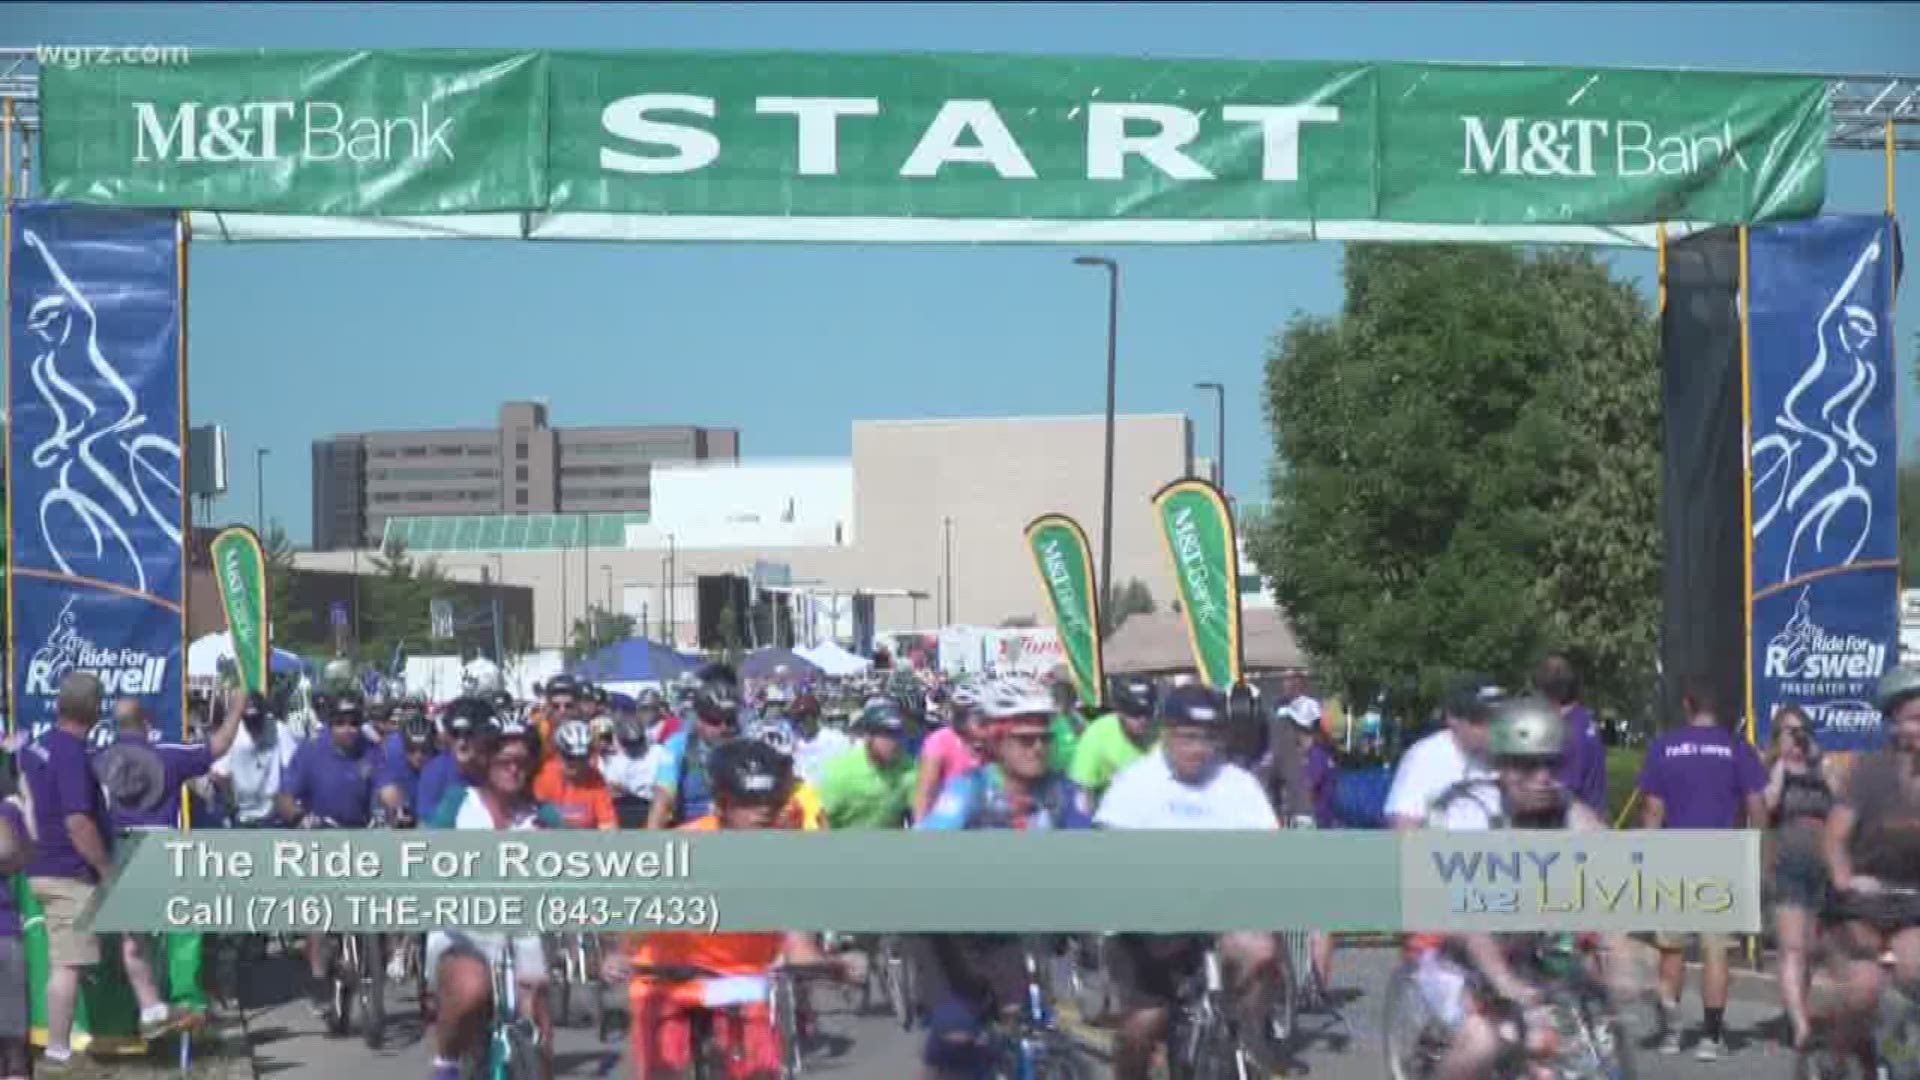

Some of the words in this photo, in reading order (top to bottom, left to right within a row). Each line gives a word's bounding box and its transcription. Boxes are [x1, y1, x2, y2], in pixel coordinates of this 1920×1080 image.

[132, 101, 297, 162] M&T
[304, 102, 455, 162] Bank
[599, 93, 1342, 182] START
[1459, 115, 1608, 176] M&T
[1616, 120, 1750, 177] Bank
[78, 648, 118, 667] Ride
[119, 649, 145, 666] For
[1763, 642, 1885, 678] Roswell
[1811, 634, 1846, 653] Ride
[1846, 634, 1869, 652] For
[25, 656, 166, 695] Rowell
